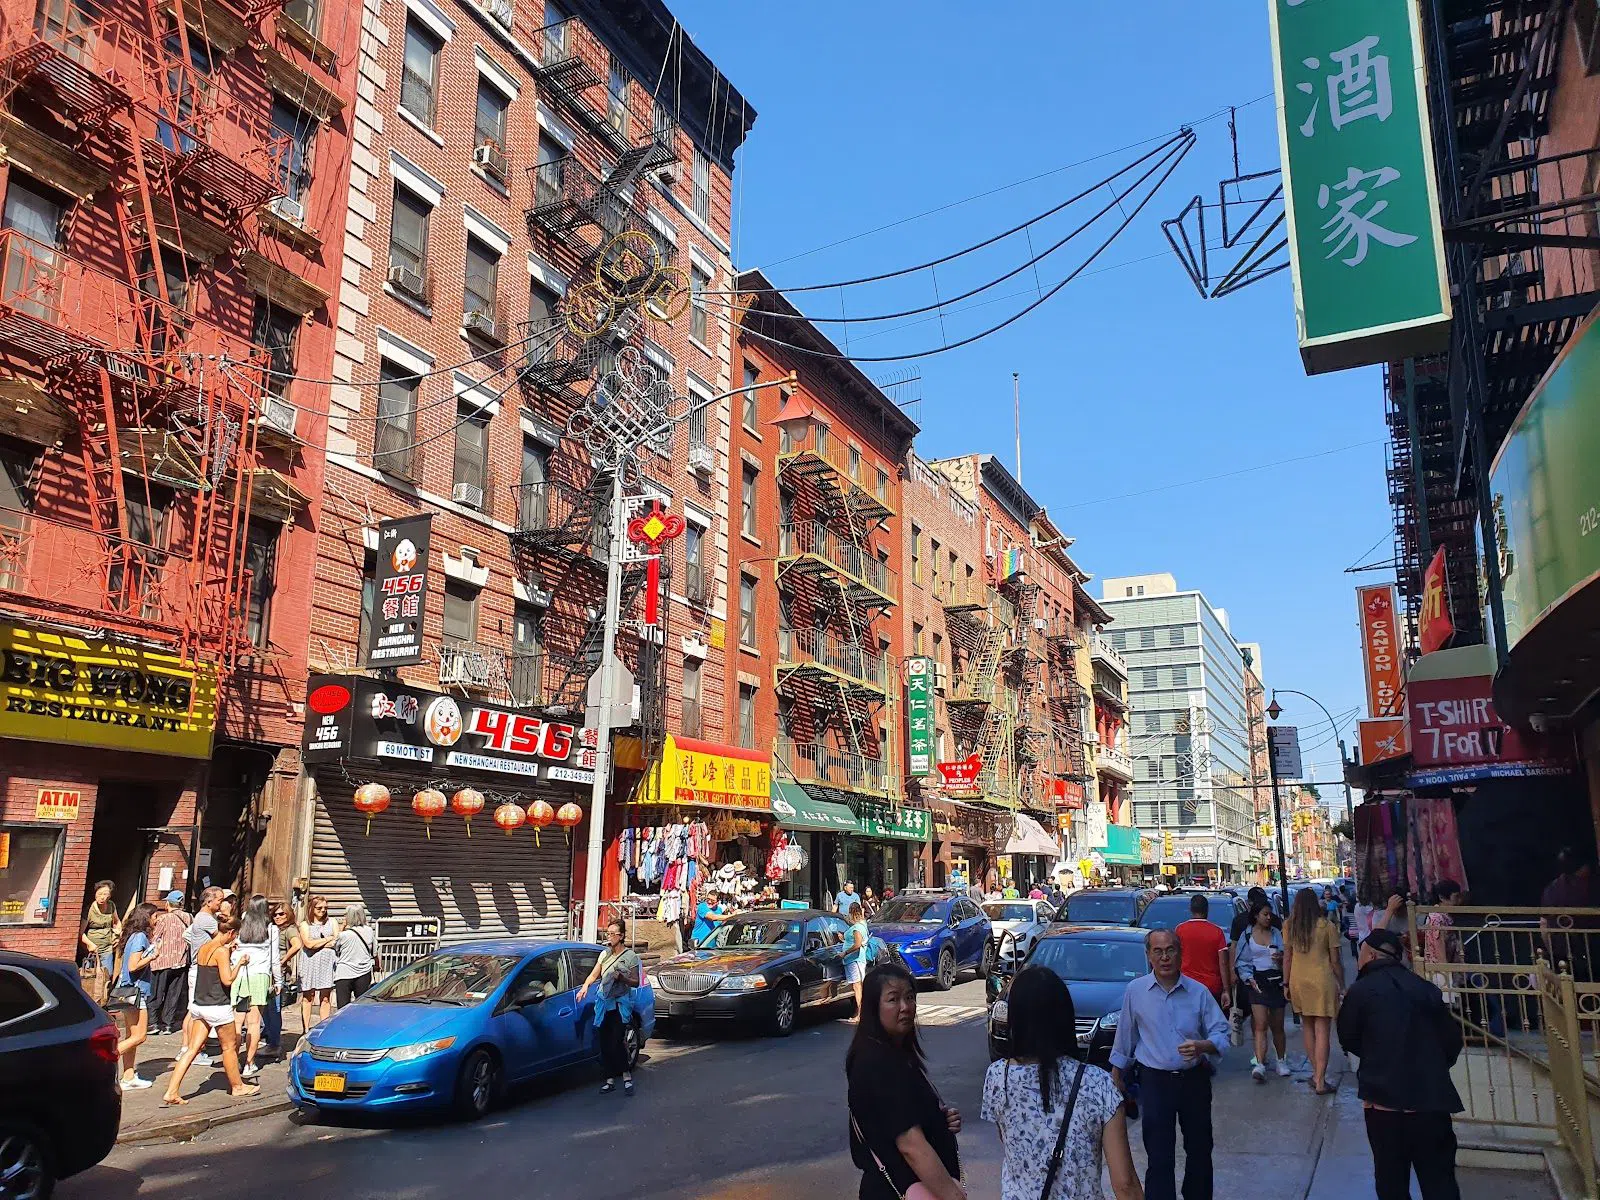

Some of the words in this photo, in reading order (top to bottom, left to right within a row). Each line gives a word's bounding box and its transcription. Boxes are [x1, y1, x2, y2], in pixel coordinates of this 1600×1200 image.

[1286, 0, 1418, 267] 酒家
[381, 574, 424, 596] 456
[382, 594, 420, 620] 餐館
[388, 623, 405, 634] NEW
[377, 634, 415, 647] SHANGHAI
[1371, 620, 1392, 672] CANTON
[371, 646, 419, 659] RESTAURANT
[4, 652, 76, 692] BIG
[88, 664, 192, 710] WONG
[1377, 680, 1397, 716] LOUN
[5, 696, 181, 732] RESTAURANT
[321, 715, 335, 726] NEW
[911, 678, 926, 752] 天仁茗茶
[315, 726, 339, 741] 456
[465, 708, 574, 760] 456
[1419, 728, 1440, 759] 7
[385, 744, 395, 755] 69
[396, 745, 419, 758] MOTT
[420, 749, 430, 759] ST
[454, 756, 468, 765] NEW
[469, 758, 499, 771] SHANGHAI
[499, 761, 536, 774] RESTAURANT
[555, 769, 596, 782] 212-349-999
[1426, 776, 1447, 784] YOON
[1450, 773, 1469, 783] PAUL
[1491, 769, 1525, 778] MICHAEL
[40, 791, 79, 806] ATM
[728, 794, 746, 807] LONG
[748, 796, 769, 808] STORE
